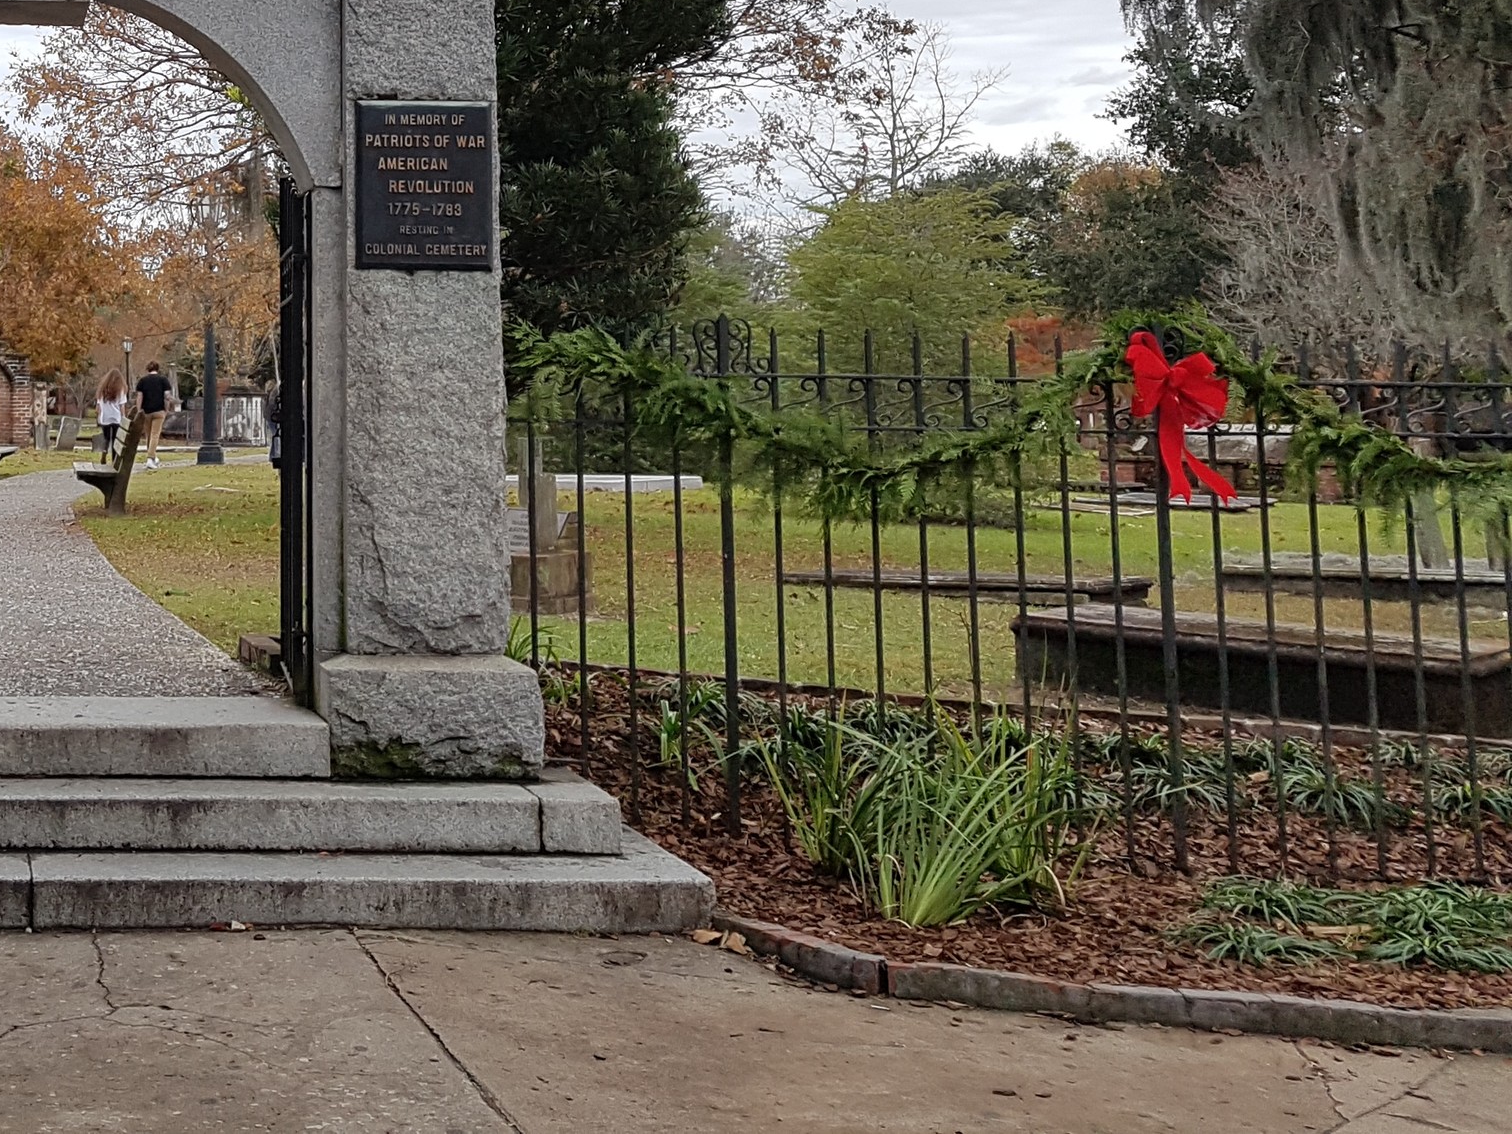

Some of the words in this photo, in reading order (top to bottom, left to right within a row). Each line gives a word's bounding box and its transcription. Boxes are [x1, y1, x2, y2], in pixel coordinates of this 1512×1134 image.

[384, 113, 396, 126] IN
[400, 113, 447, 126] MEMORY
[451, 113, 466, 126] OF
[365, 134, 430, 148] PATRIOTS
[434, 134, 450, 148] OF
[456, 135, 486, 149] WAR
[378, 157, 448, 171] AMERICAN
[388, 179, 475, 194] REVOLUTION
[399, 225, 439, 235] RESTING
[443, 225, 454, 235] IN
[365, 243, 420, 256] COLONIAL
[425, 244, 487, 256] CEMETERY
